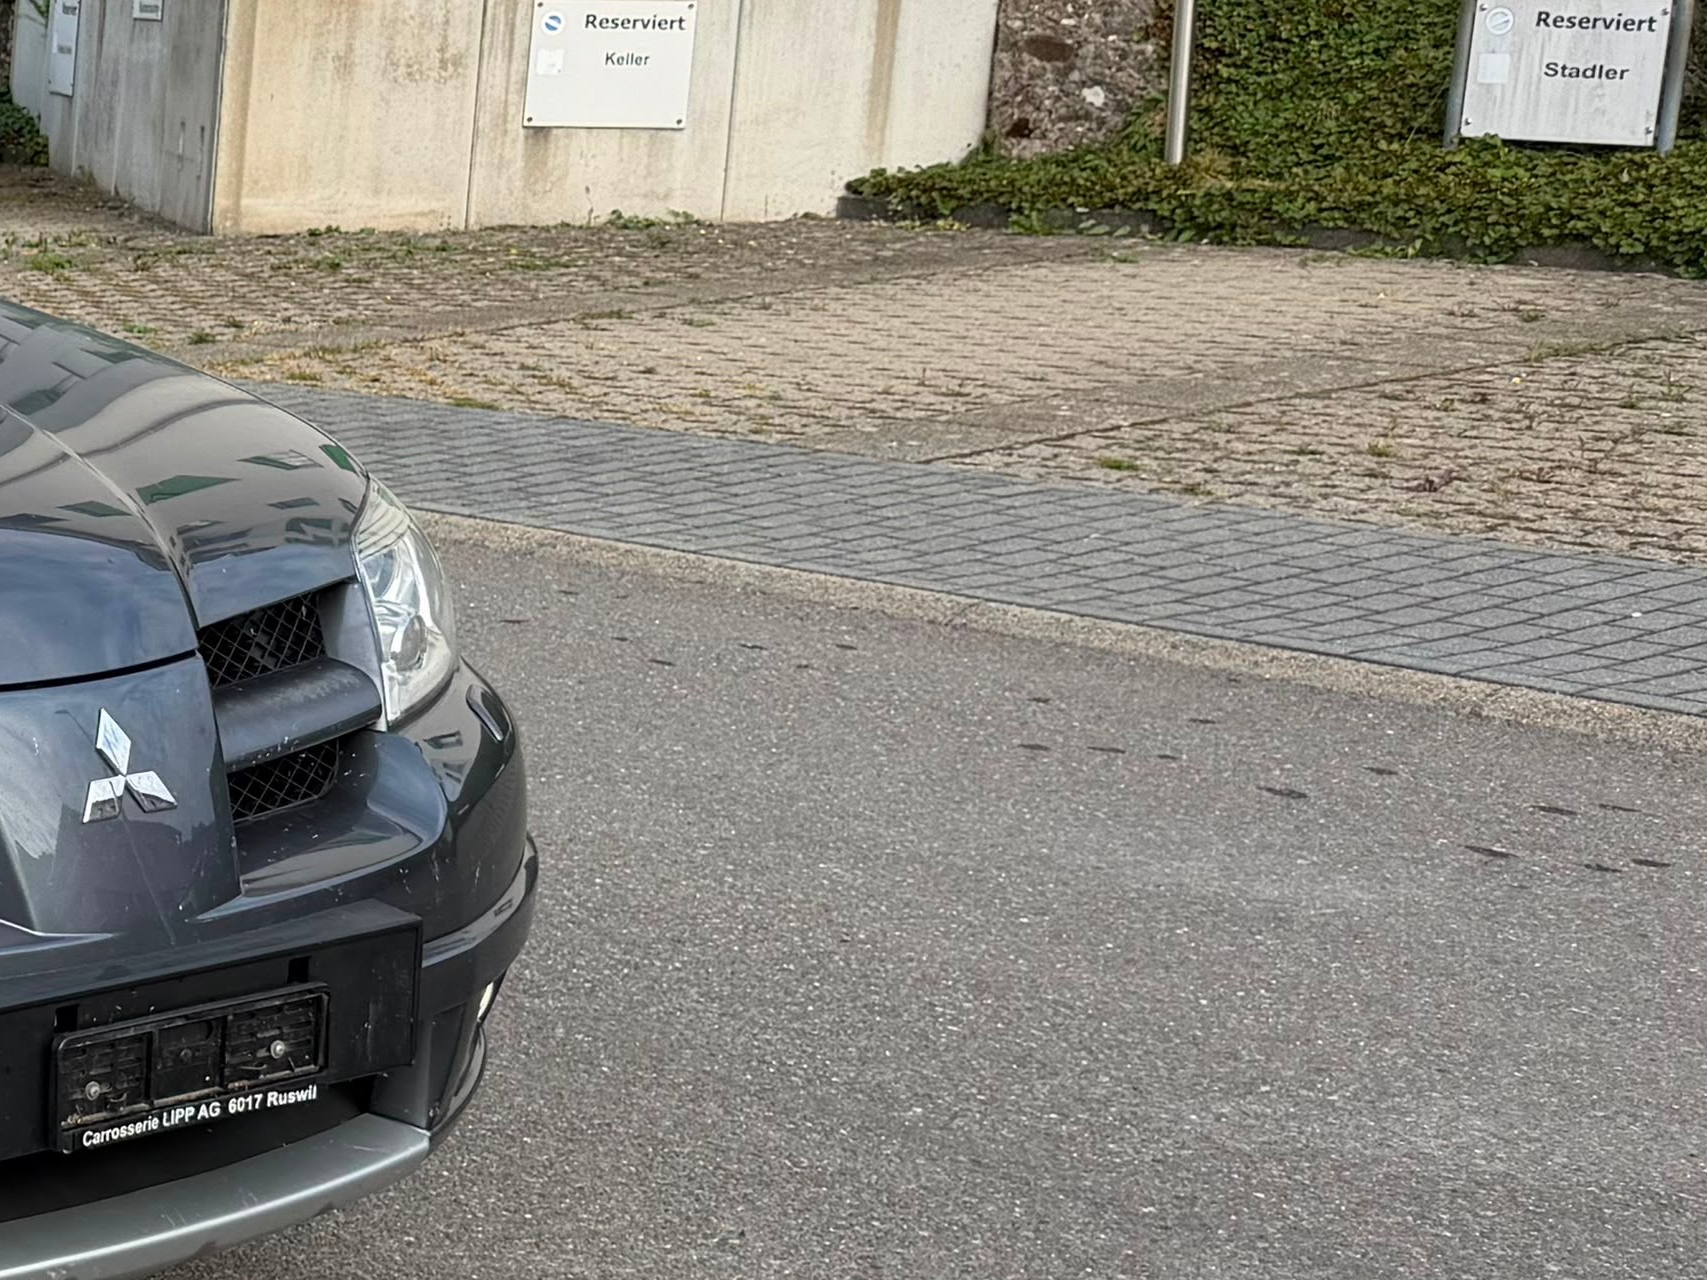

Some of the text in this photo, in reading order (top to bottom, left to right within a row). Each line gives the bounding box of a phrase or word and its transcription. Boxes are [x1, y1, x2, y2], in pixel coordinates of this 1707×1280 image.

[584, 14, 686, 31] Reserviert
[1535, 11, 1657, 32] Reserviert
[605, 52, 650, 66] Keller
[1544, 62, 1630, 80] Stadler
[82, 1085, 318, 1147] Carrosserie LIPP AG 6017 Ruswil
